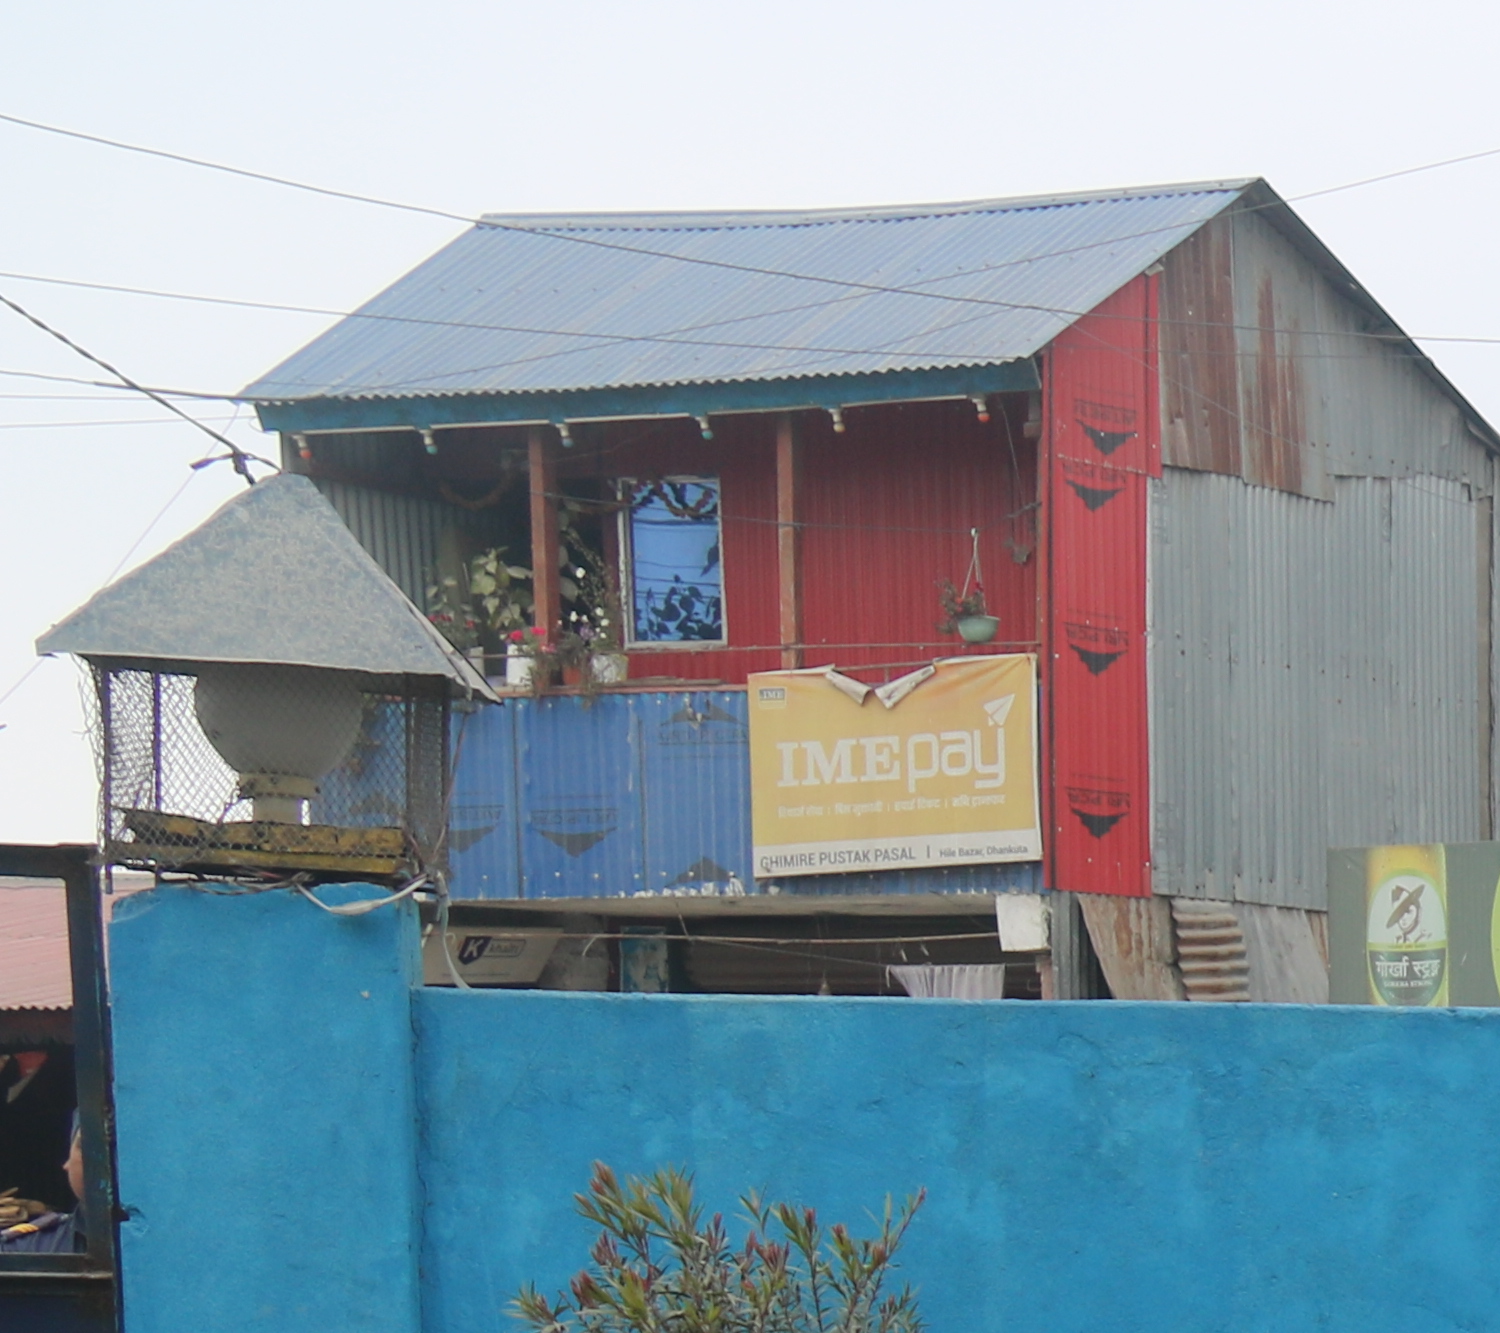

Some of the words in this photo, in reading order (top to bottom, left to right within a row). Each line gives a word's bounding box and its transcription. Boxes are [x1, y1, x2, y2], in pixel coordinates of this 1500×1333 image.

[760, 853, 816, 869] GHIMIRE
[818, 850, 871, 865] PUSTAK
[874, 847, 917, 862] PASAL
[986, 845, 1028, 856] Dhankuta
[1375, 955, 1410, 978] गोर्खा
